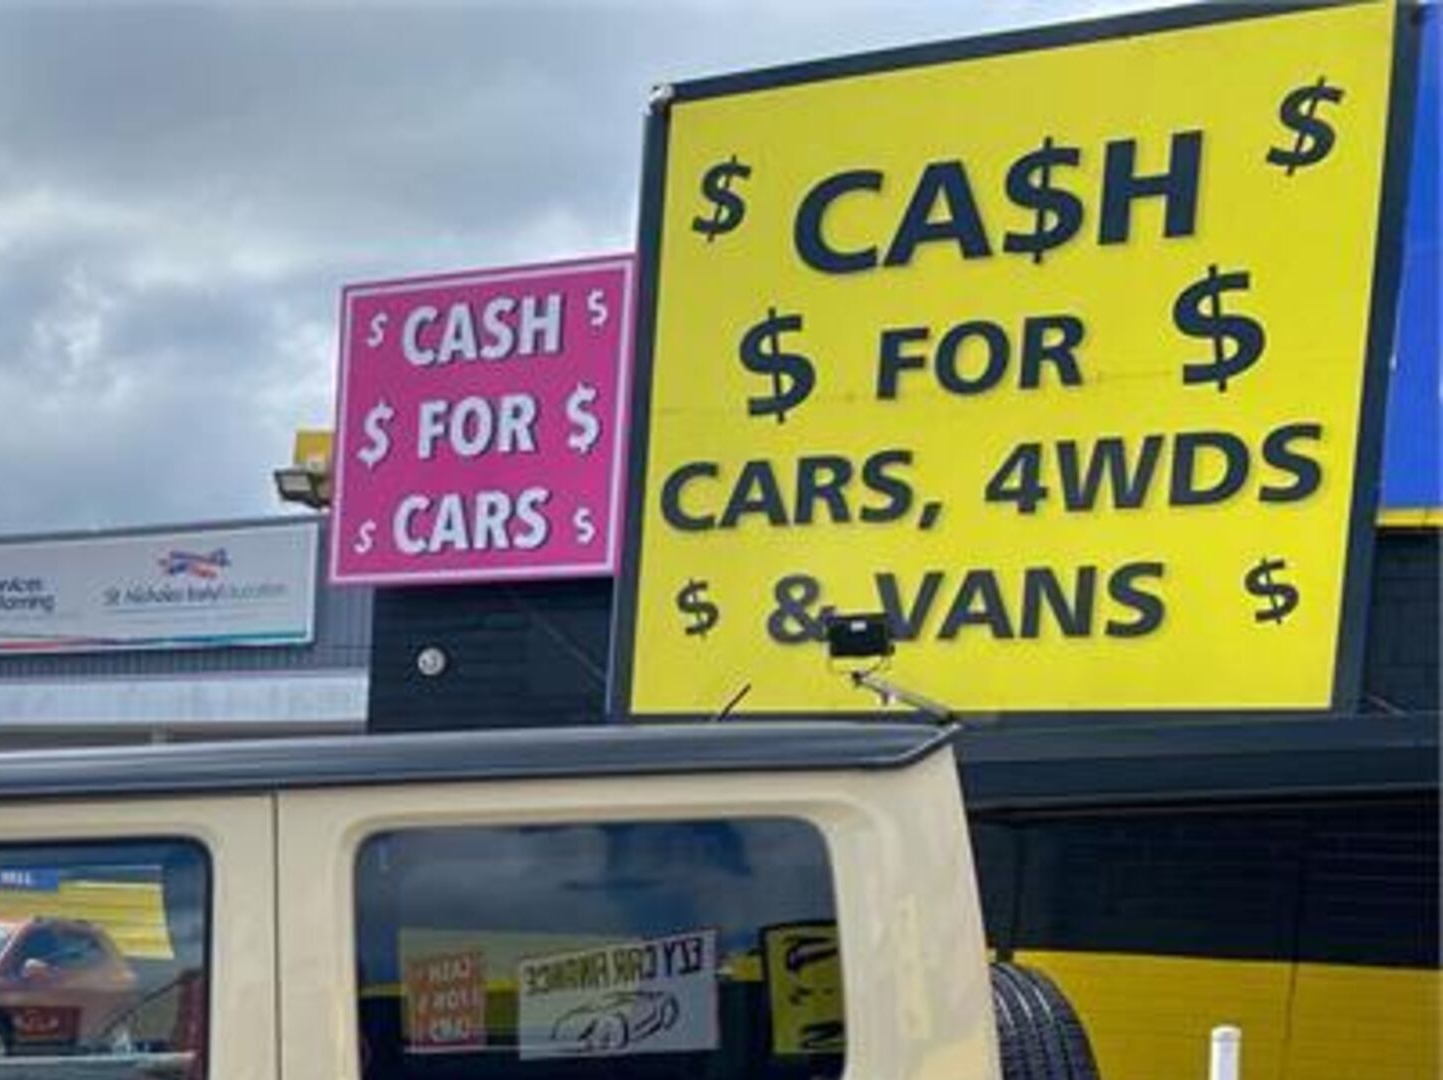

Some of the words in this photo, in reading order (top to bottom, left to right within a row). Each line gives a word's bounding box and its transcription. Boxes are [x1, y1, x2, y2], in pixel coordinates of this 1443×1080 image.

[793, 130, 1204, 274] CA$H
[402, 295, 562, 366] CASH
[876, 316, 1084, 399] FOR
[417, 394, 538, 460] FOR
[659, 449, 943, 532] CARS,
[984, 423, 1324, 514] 4WDS
[393, 487, 551, 555] CARS
[875, 561, 1167, 645] VANS
